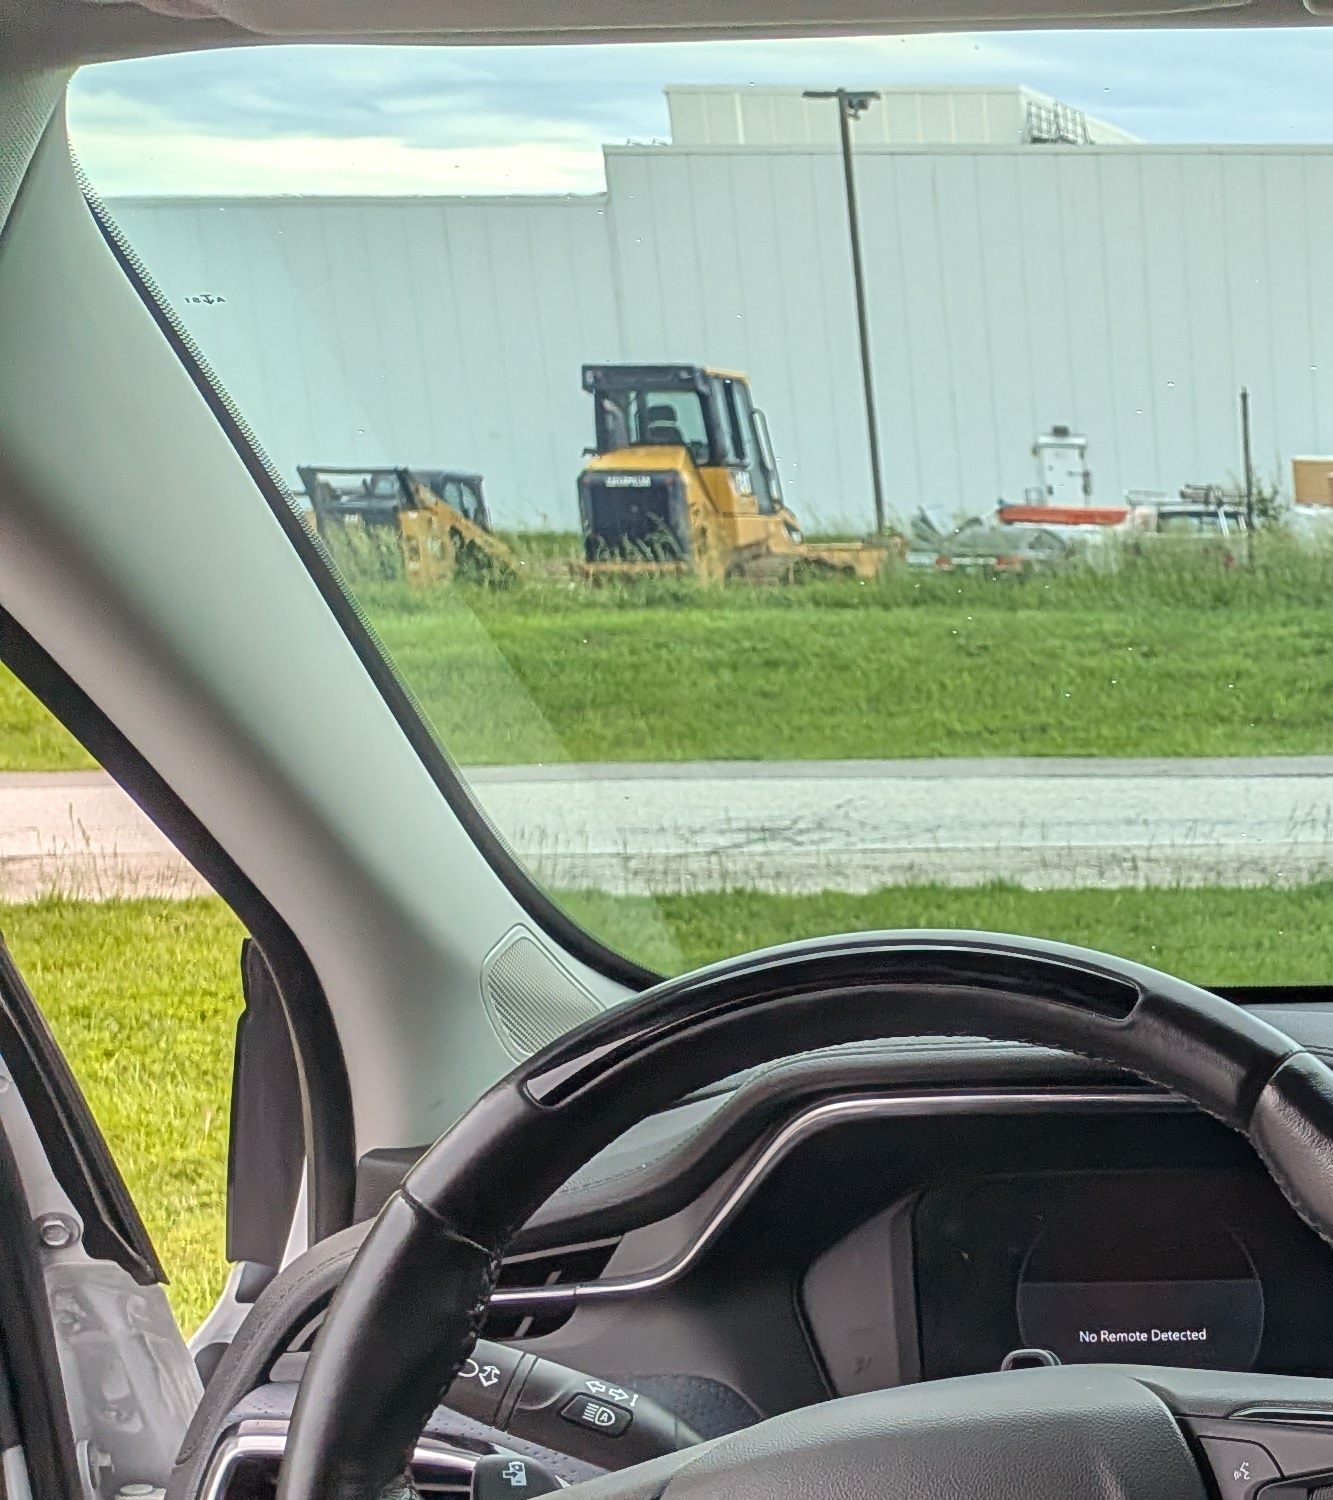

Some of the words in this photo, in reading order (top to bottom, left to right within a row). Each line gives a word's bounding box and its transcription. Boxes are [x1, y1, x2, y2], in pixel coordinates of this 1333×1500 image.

[1079, 1330, 1098, 1343] No
[1100, 1329, 1148, 1343] Remote
[1151, 1327, 1208, 1341] Detected
